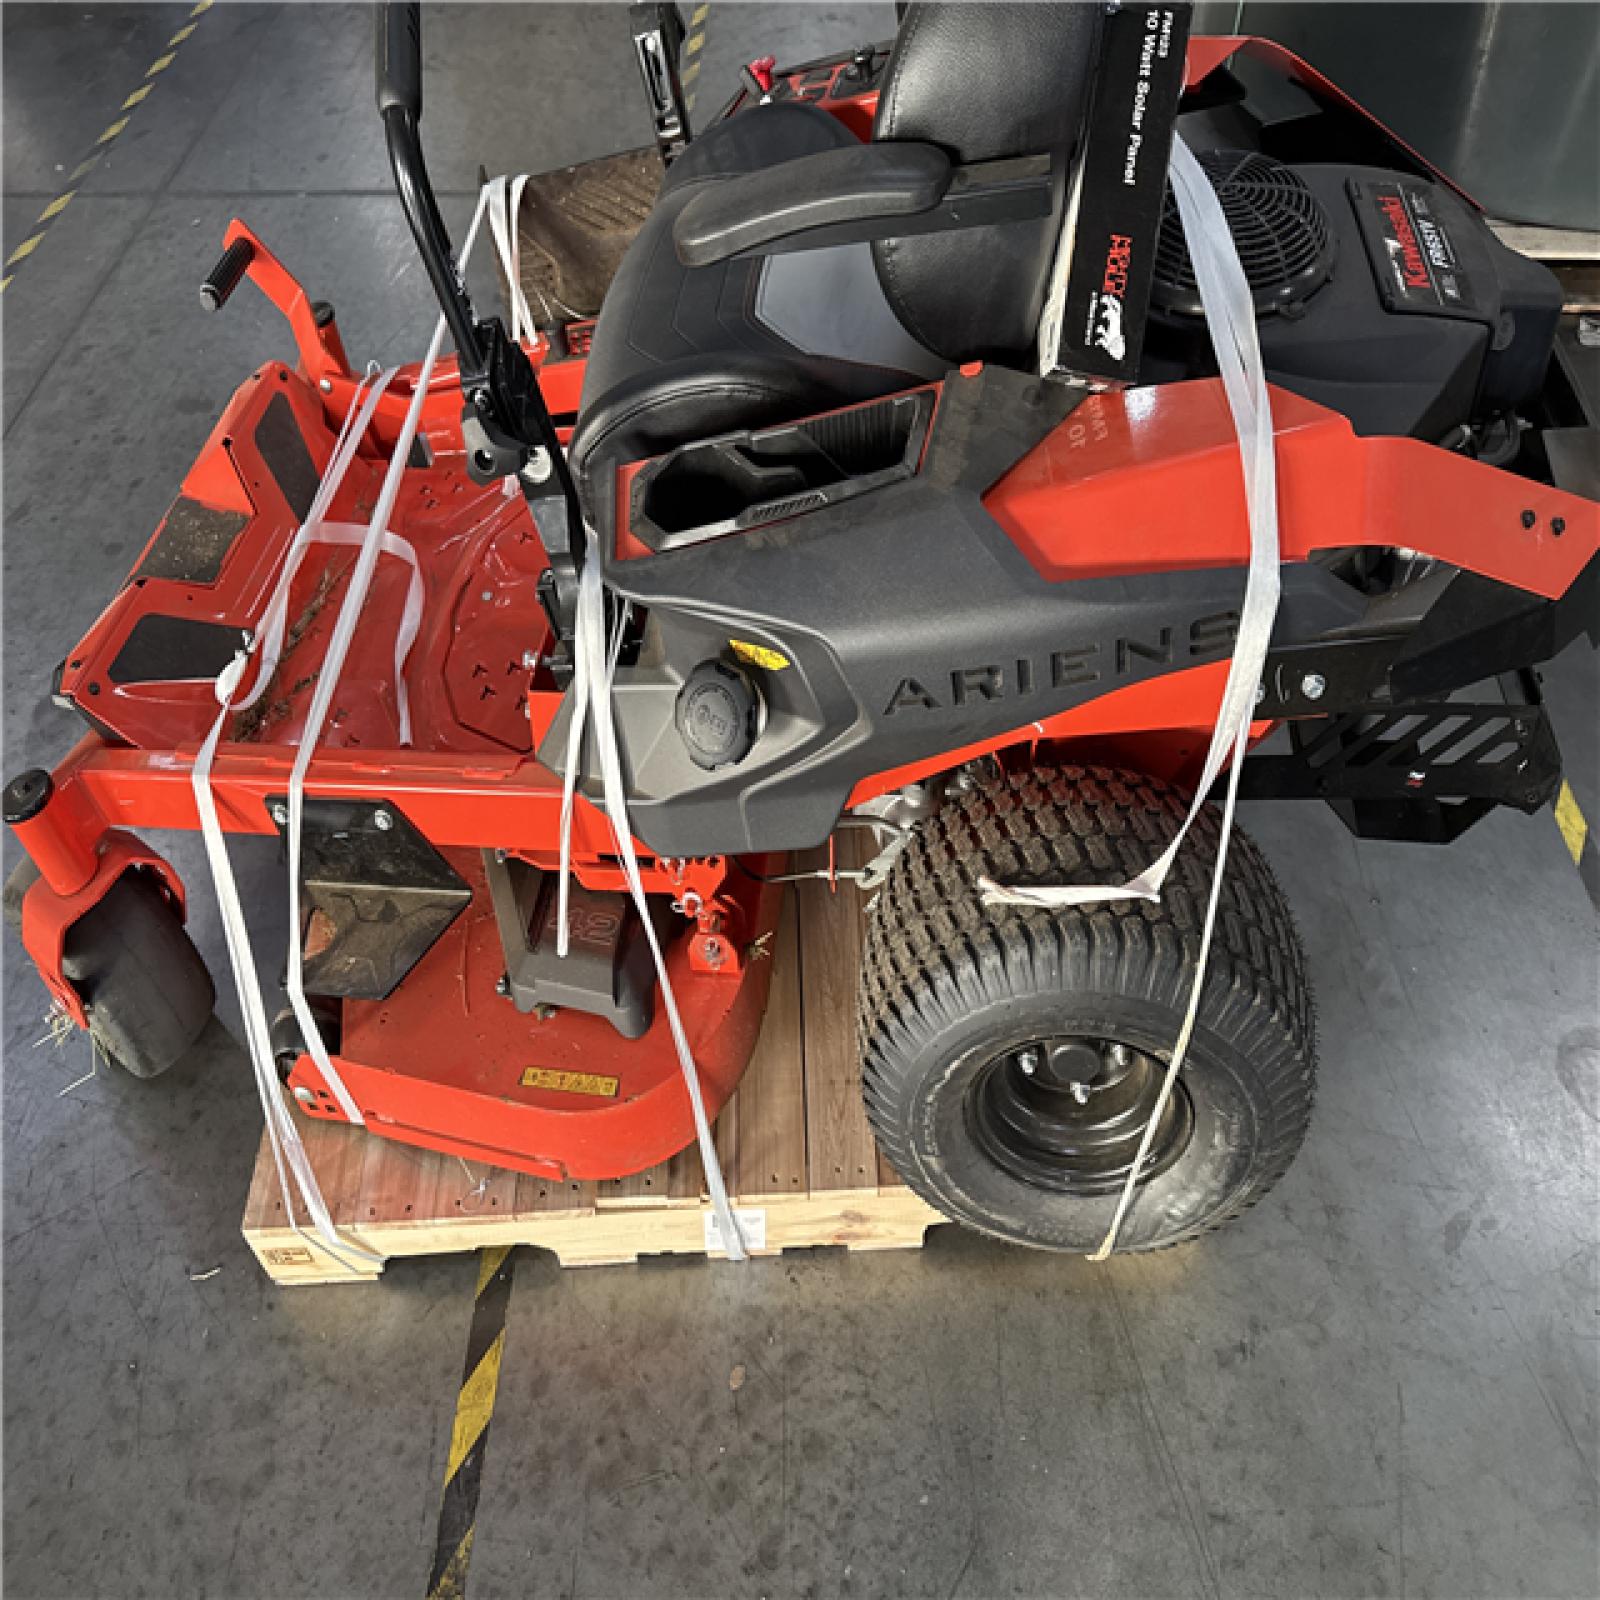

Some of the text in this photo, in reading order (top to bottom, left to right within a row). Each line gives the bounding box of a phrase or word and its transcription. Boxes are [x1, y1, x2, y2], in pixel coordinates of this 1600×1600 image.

[1124, 10, 1159, 185] 10 Watt Solar Panel
[1377, 196, 1431, 288] Kawasaki
[882, 610, 1242, 716] ARIENS
